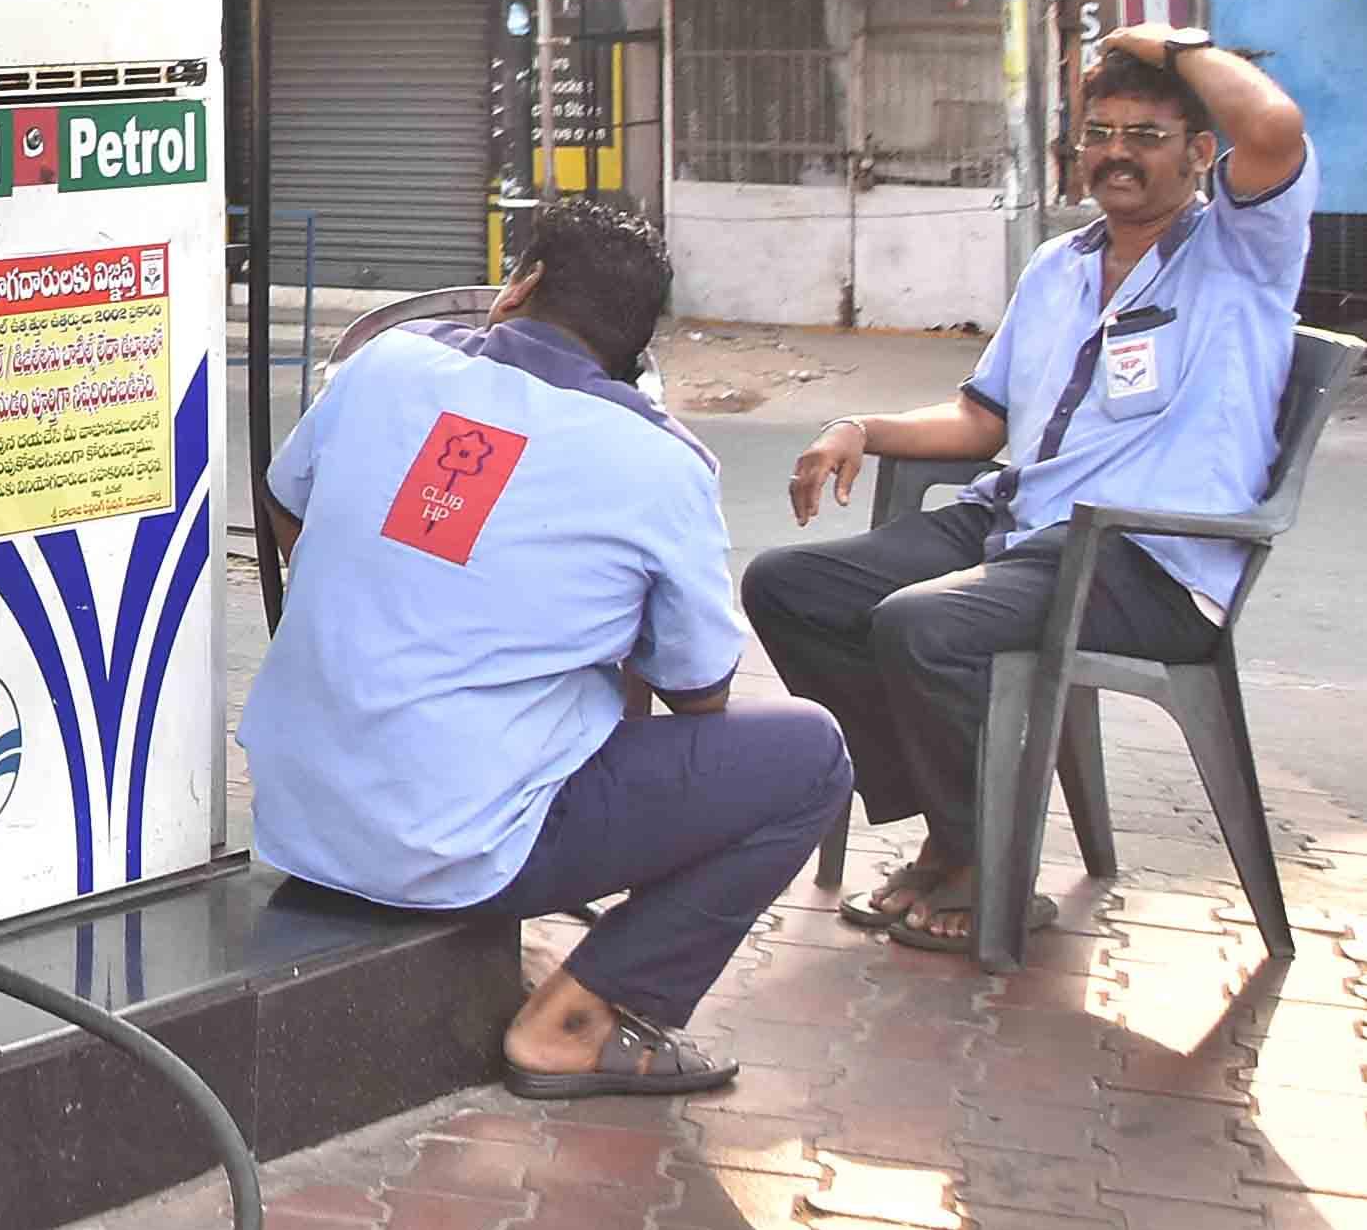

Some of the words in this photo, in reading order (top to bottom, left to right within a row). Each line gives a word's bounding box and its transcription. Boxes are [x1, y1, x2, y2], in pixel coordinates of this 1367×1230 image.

[69, 112, 196, 180] Petrol
[95, 310, 127, 323] 2002
[422, 485, 464, 510] CLUB
[422, 503, 449, 521] HP
